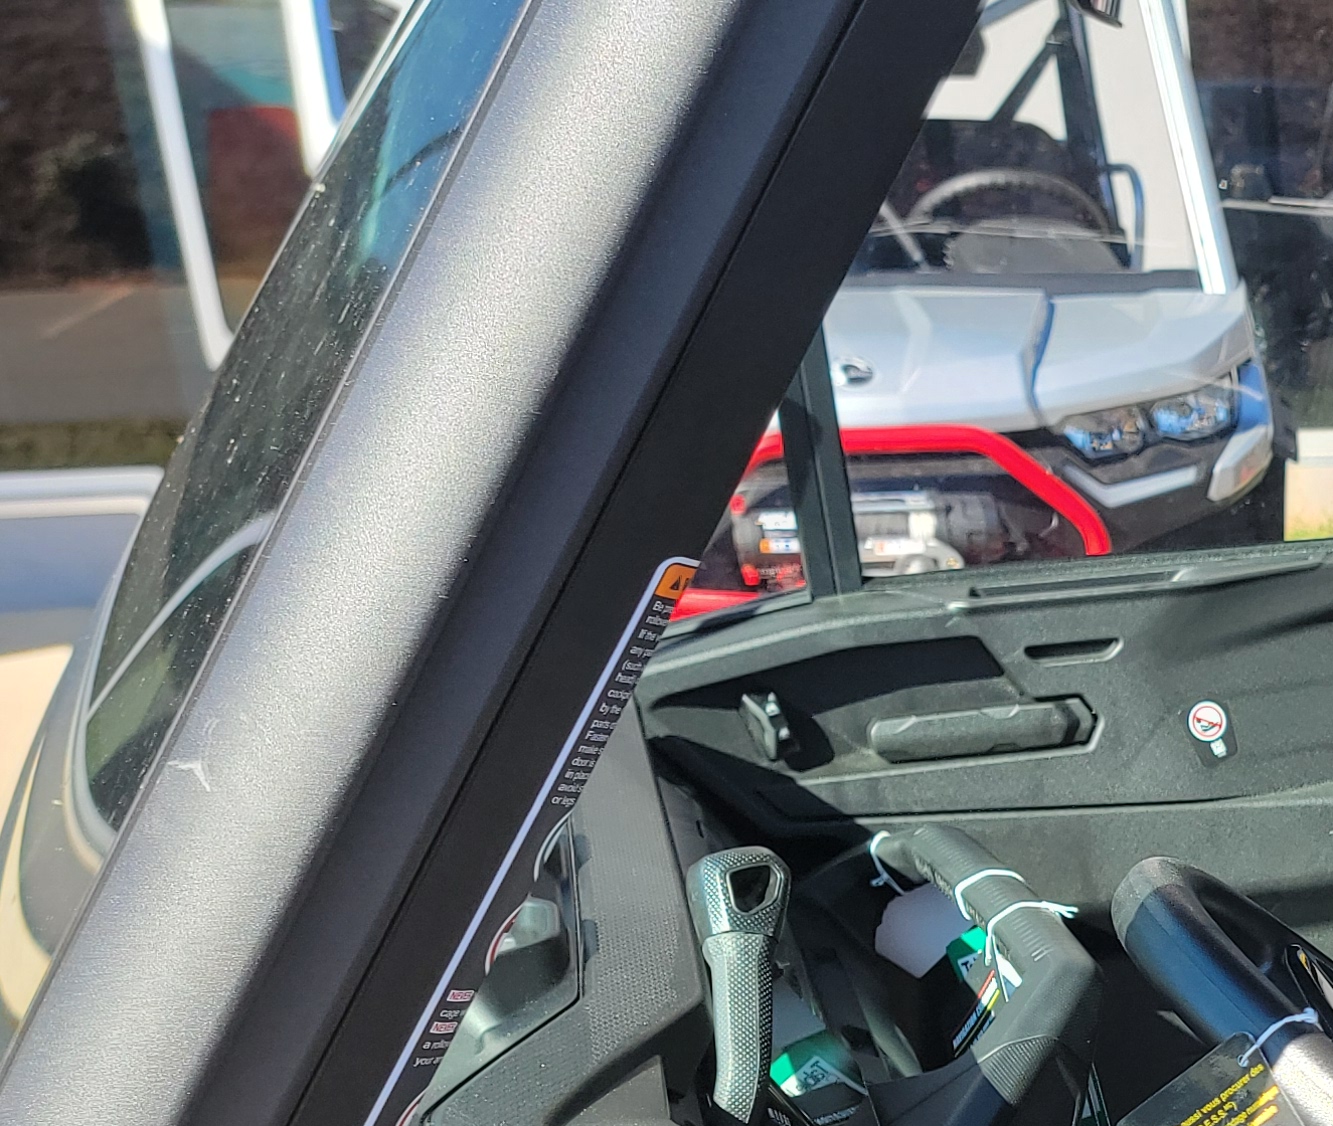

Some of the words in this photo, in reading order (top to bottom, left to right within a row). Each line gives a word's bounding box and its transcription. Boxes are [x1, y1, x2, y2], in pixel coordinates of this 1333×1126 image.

[1200, 1096, 1221, 1114] vous
[1218, 1073, 1251, 1101] procurer
[1247, 1062, 1264, 1077] des
